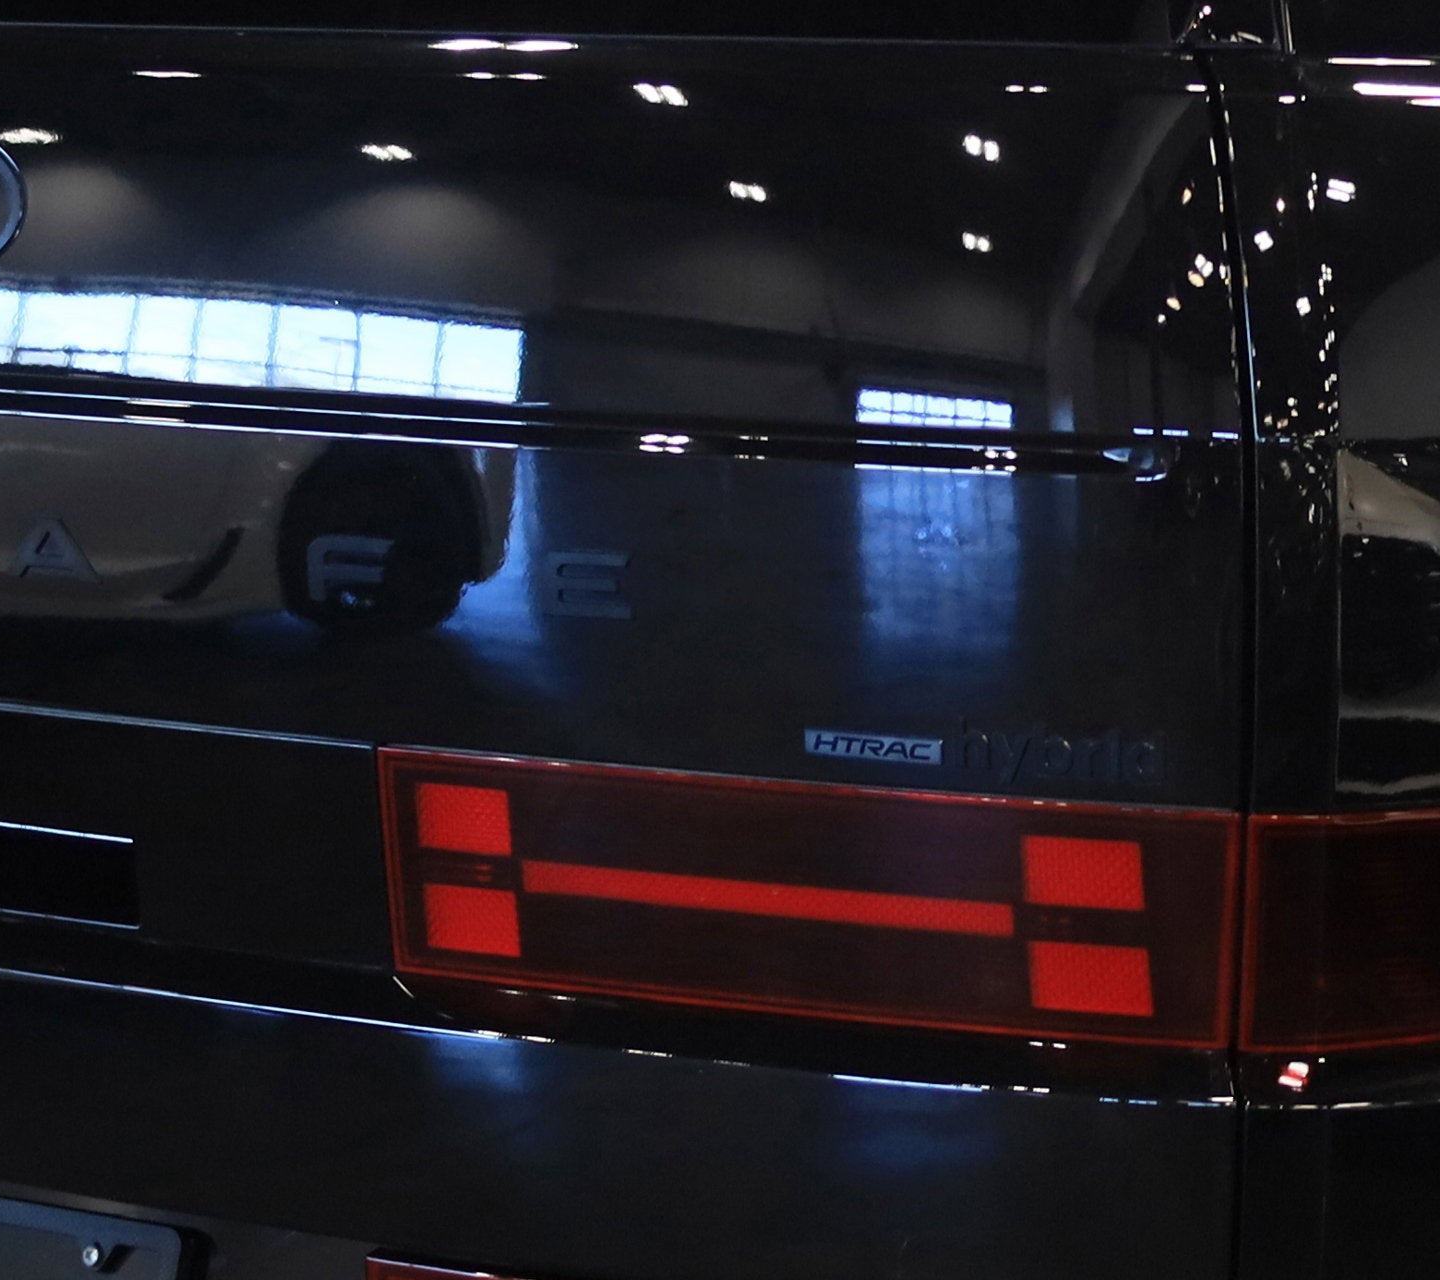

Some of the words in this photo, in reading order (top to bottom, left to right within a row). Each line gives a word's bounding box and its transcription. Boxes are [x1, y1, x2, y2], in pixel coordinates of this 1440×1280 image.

[305, 530, 633, 620] FE
[812, 734, 933, 761] HTRAC
[953, 715, 1167, 786] hybrid
